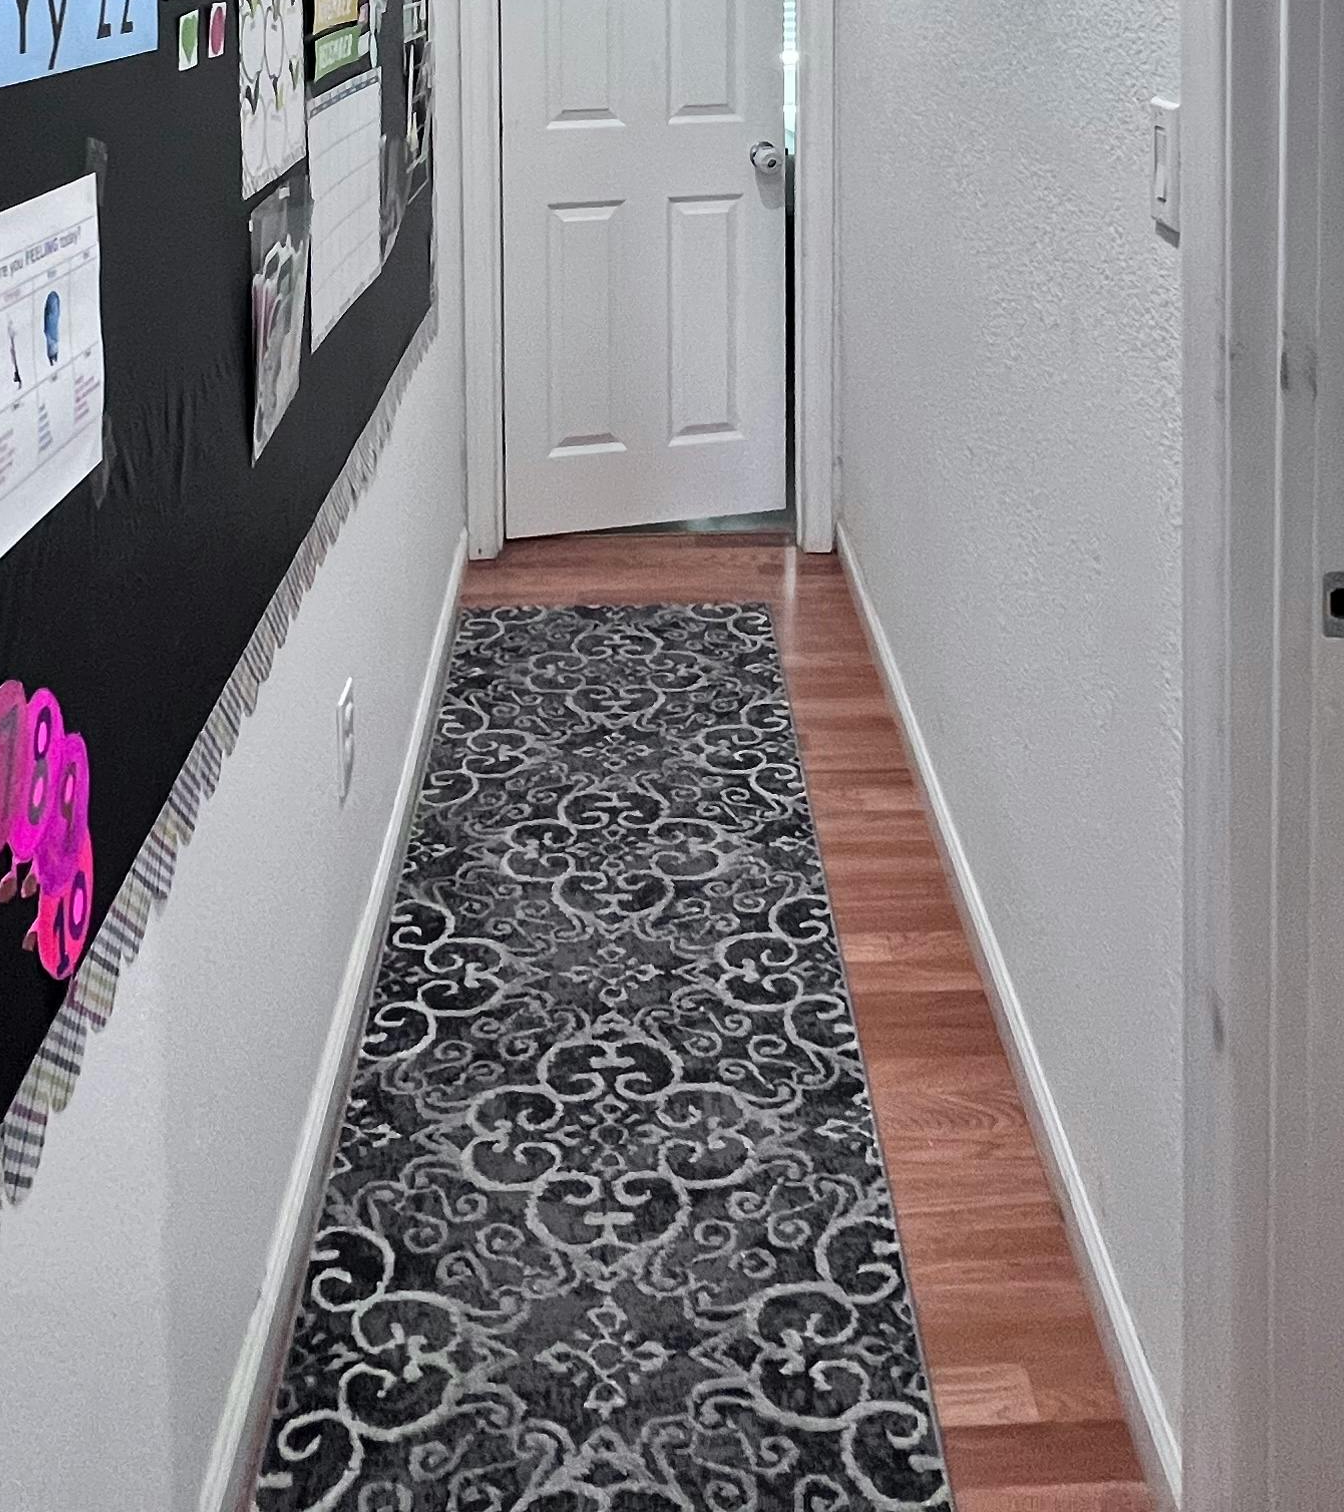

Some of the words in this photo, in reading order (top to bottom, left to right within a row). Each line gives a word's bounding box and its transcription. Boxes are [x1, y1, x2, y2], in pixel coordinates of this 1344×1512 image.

[9, 257, 24, 279] you
[25, 237, 59, 267] FEELING
[28, 705, 52, 826] 8
[60, 761, 77, 845] 9
[54, 870, 89, 978] 10
